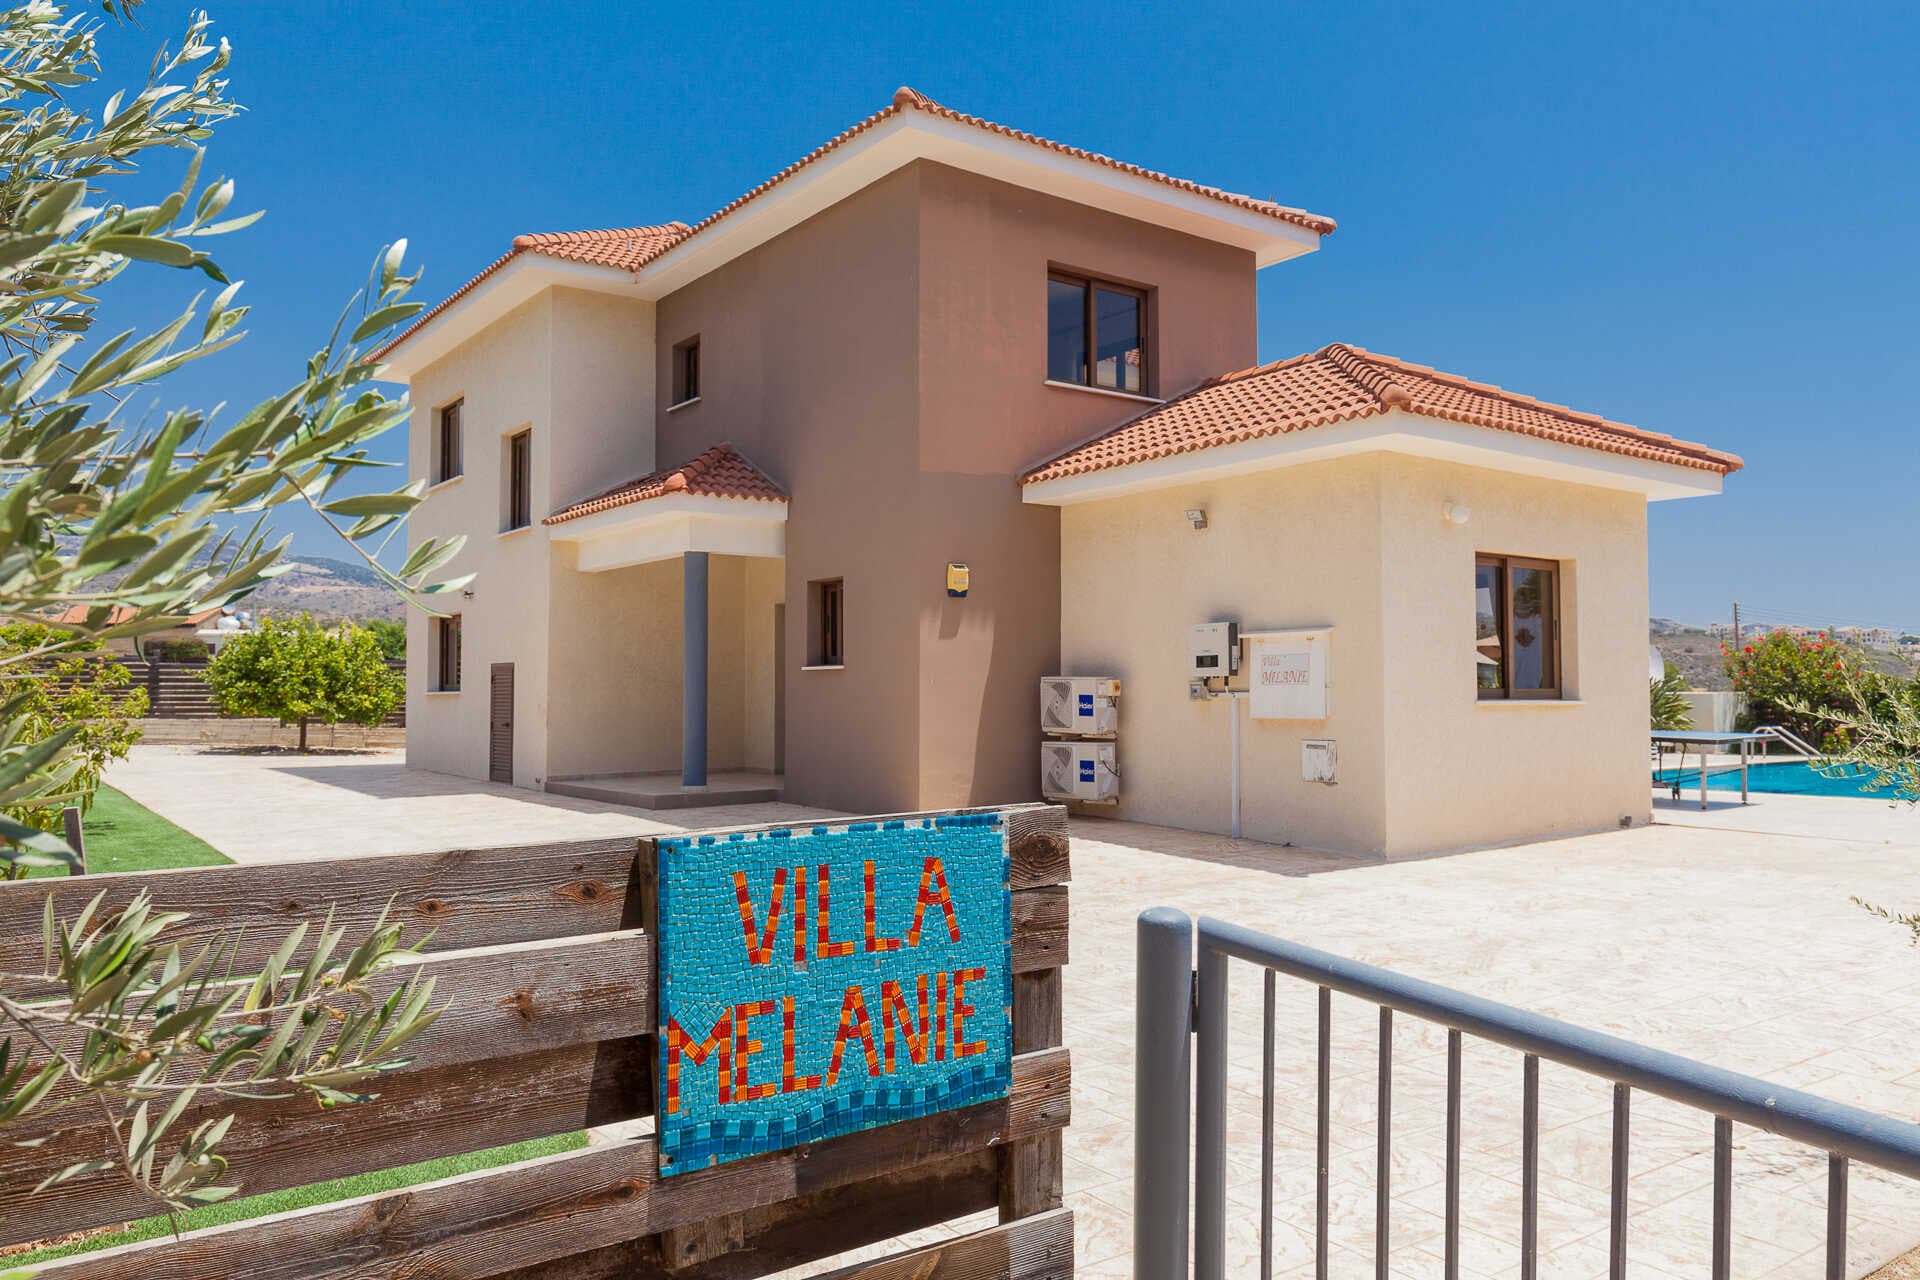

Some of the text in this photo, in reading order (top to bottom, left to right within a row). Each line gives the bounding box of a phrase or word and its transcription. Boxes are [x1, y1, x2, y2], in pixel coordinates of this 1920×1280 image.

[1263, 670, 1308, 685] MELANIE
[733, 857, 961, 965] VILLA
[666, 967, 986, 1114] MELANIE
